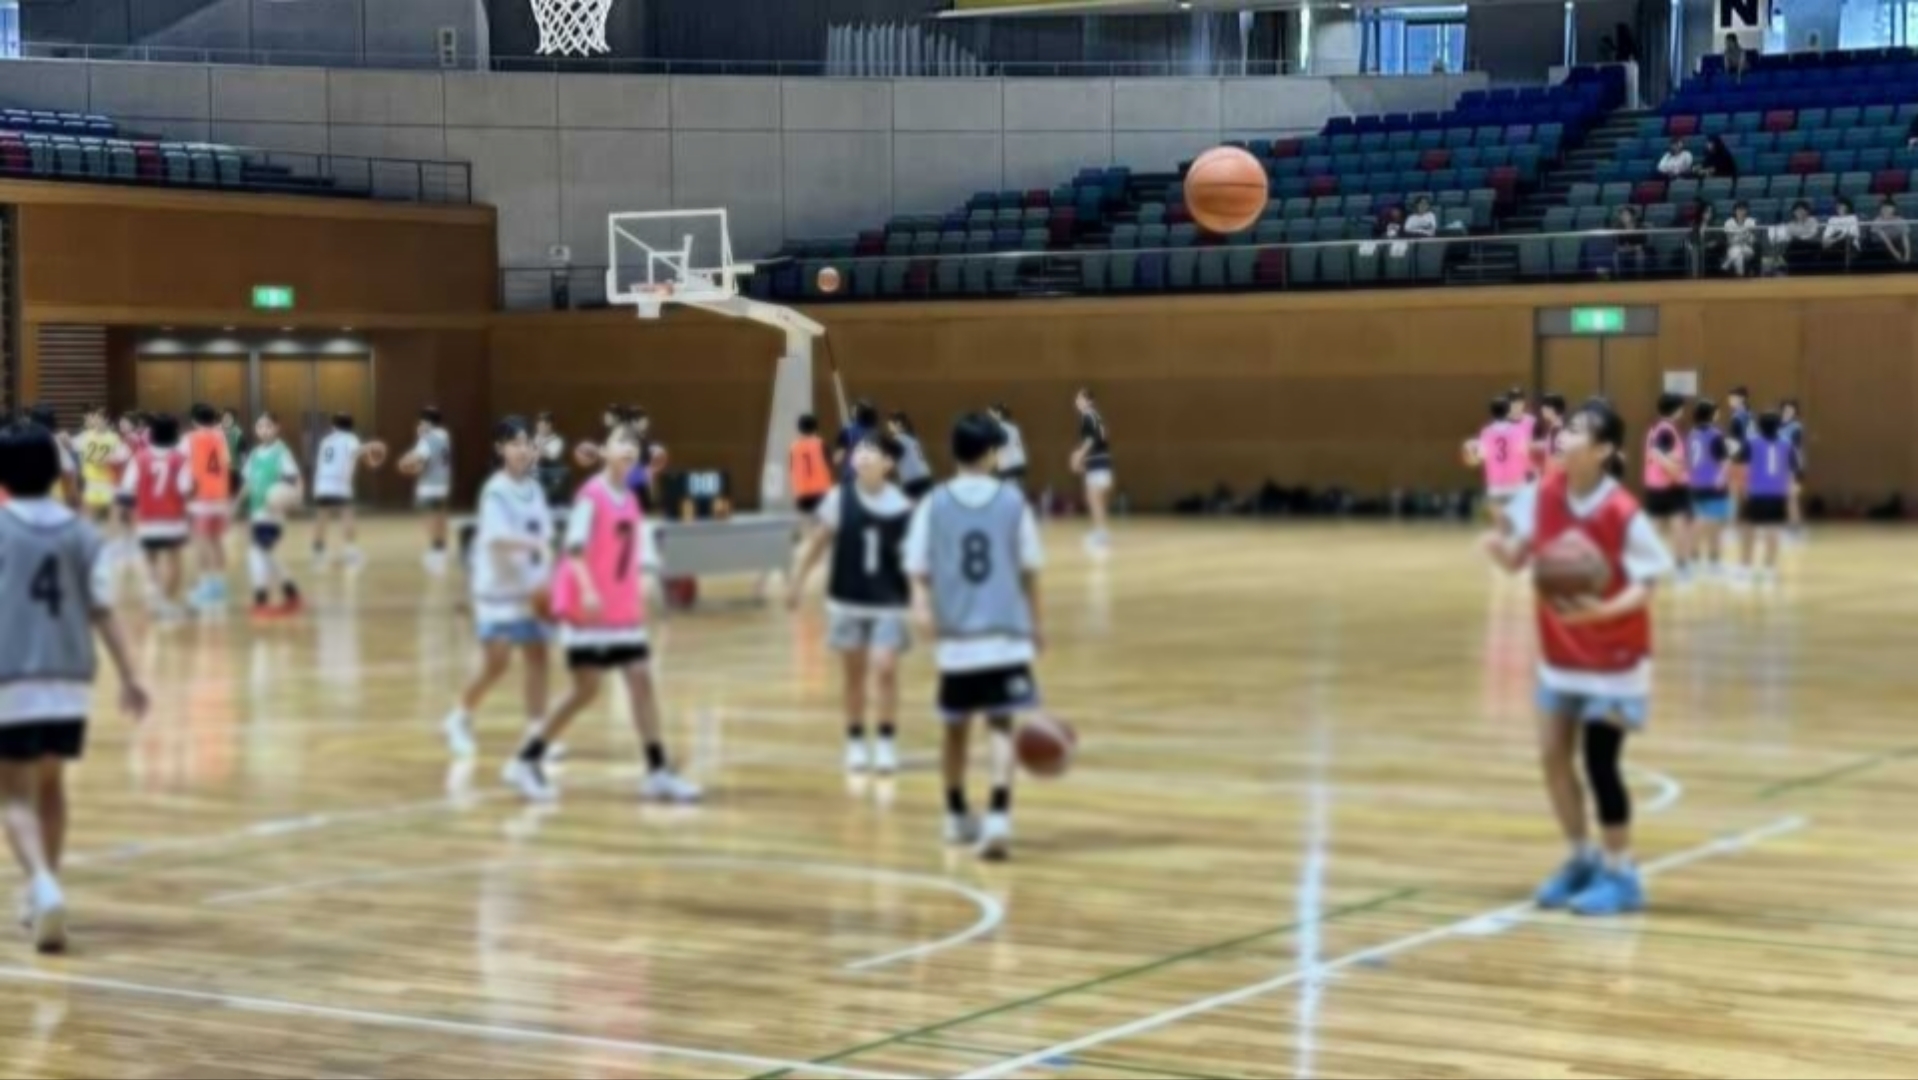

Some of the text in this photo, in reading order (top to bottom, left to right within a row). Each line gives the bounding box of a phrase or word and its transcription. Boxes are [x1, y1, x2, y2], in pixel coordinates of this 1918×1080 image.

[1720, 0, 1758, 27] N
[206, 448, 221, 478] 4
[803, 452, 813, 478] 1
[1495, 437, 1507, 463] 3
[1767, 445, 1777, 476] 1
[152, 461, 170, 497] 7
[614, 520, 633, 581] 7
[863, 528, 879, 575] 1
[962, 529, 992, 585] 8
[31, 553, 62, 618] 4
